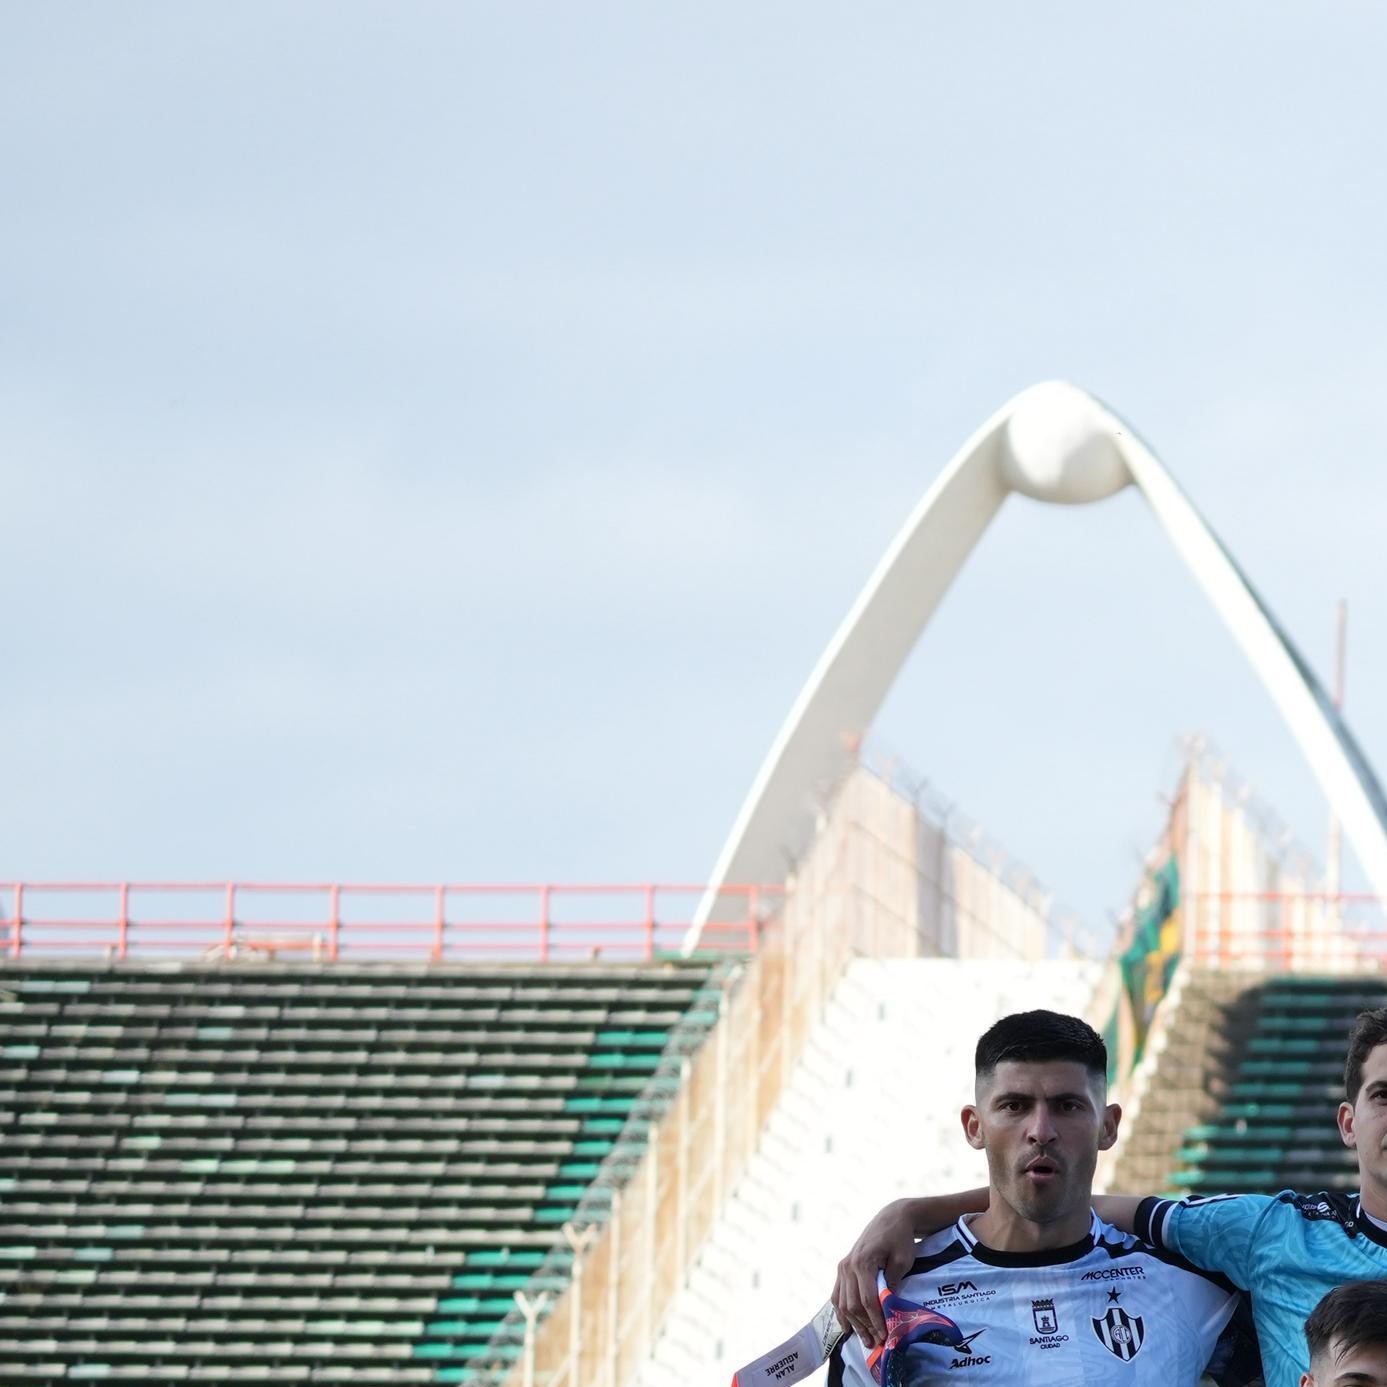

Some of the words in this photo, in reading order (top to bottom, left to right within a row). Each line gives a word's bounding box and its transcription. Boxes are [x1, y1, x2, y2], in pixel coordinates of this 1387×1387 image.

[938, 1281, 977, 1296] ISM
[1029, 1335, 1069, 1345] SANTIAGO
[765, 1352, 799, 1377] AGUERRE
[950, 1355, 991, 1369] Adhoc
[776, 1364, 795, 1381] ALAN
